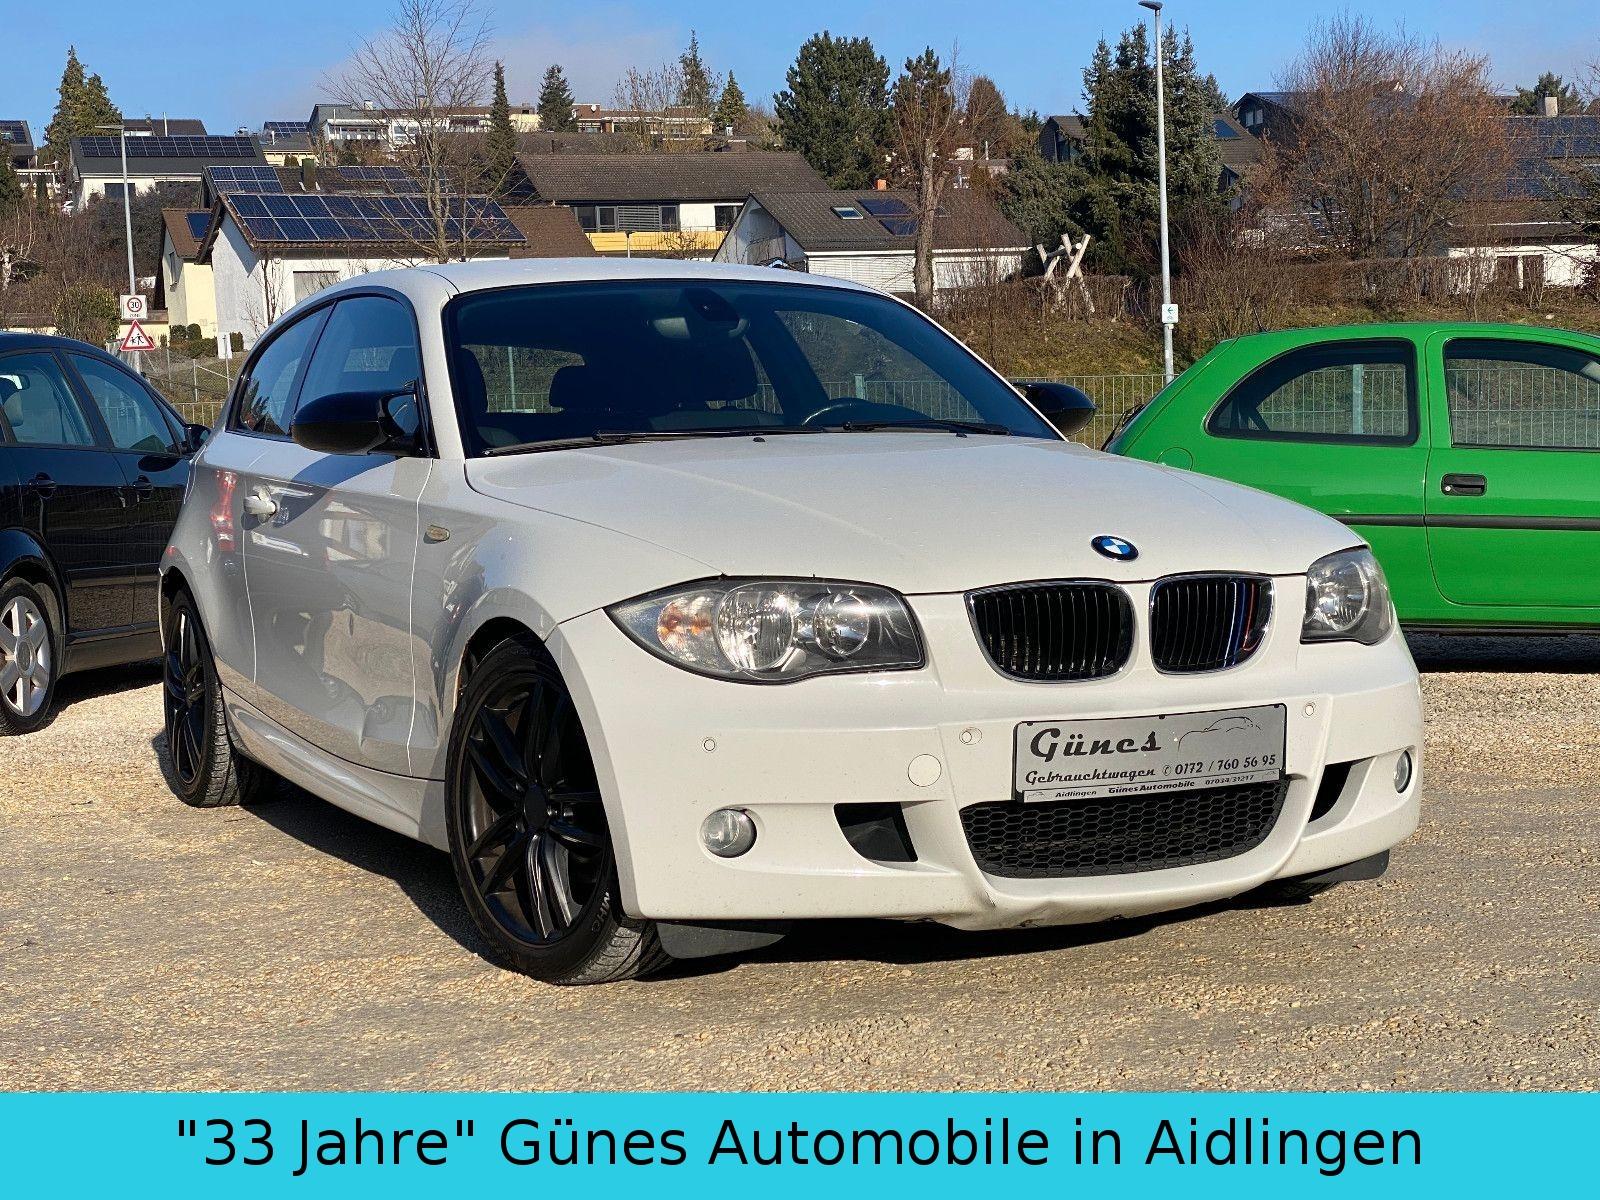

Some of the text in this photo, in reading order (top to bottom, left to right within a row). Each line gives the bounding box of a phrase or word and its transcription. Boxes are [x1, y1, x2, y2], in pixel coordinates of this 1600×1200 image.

[1030, 727, 1162, 762] Günes
[1025, 769, 1156, 785] Gebrauchtwagen
[1174, 761, 1203, 775] 0172
[1217, 758, 1239, 771] 760
[1243, 756, 1258, 769] 56
[1262, 754, 1276, 766] 95
[1055, 790, 1097, 798] Aidlingen
